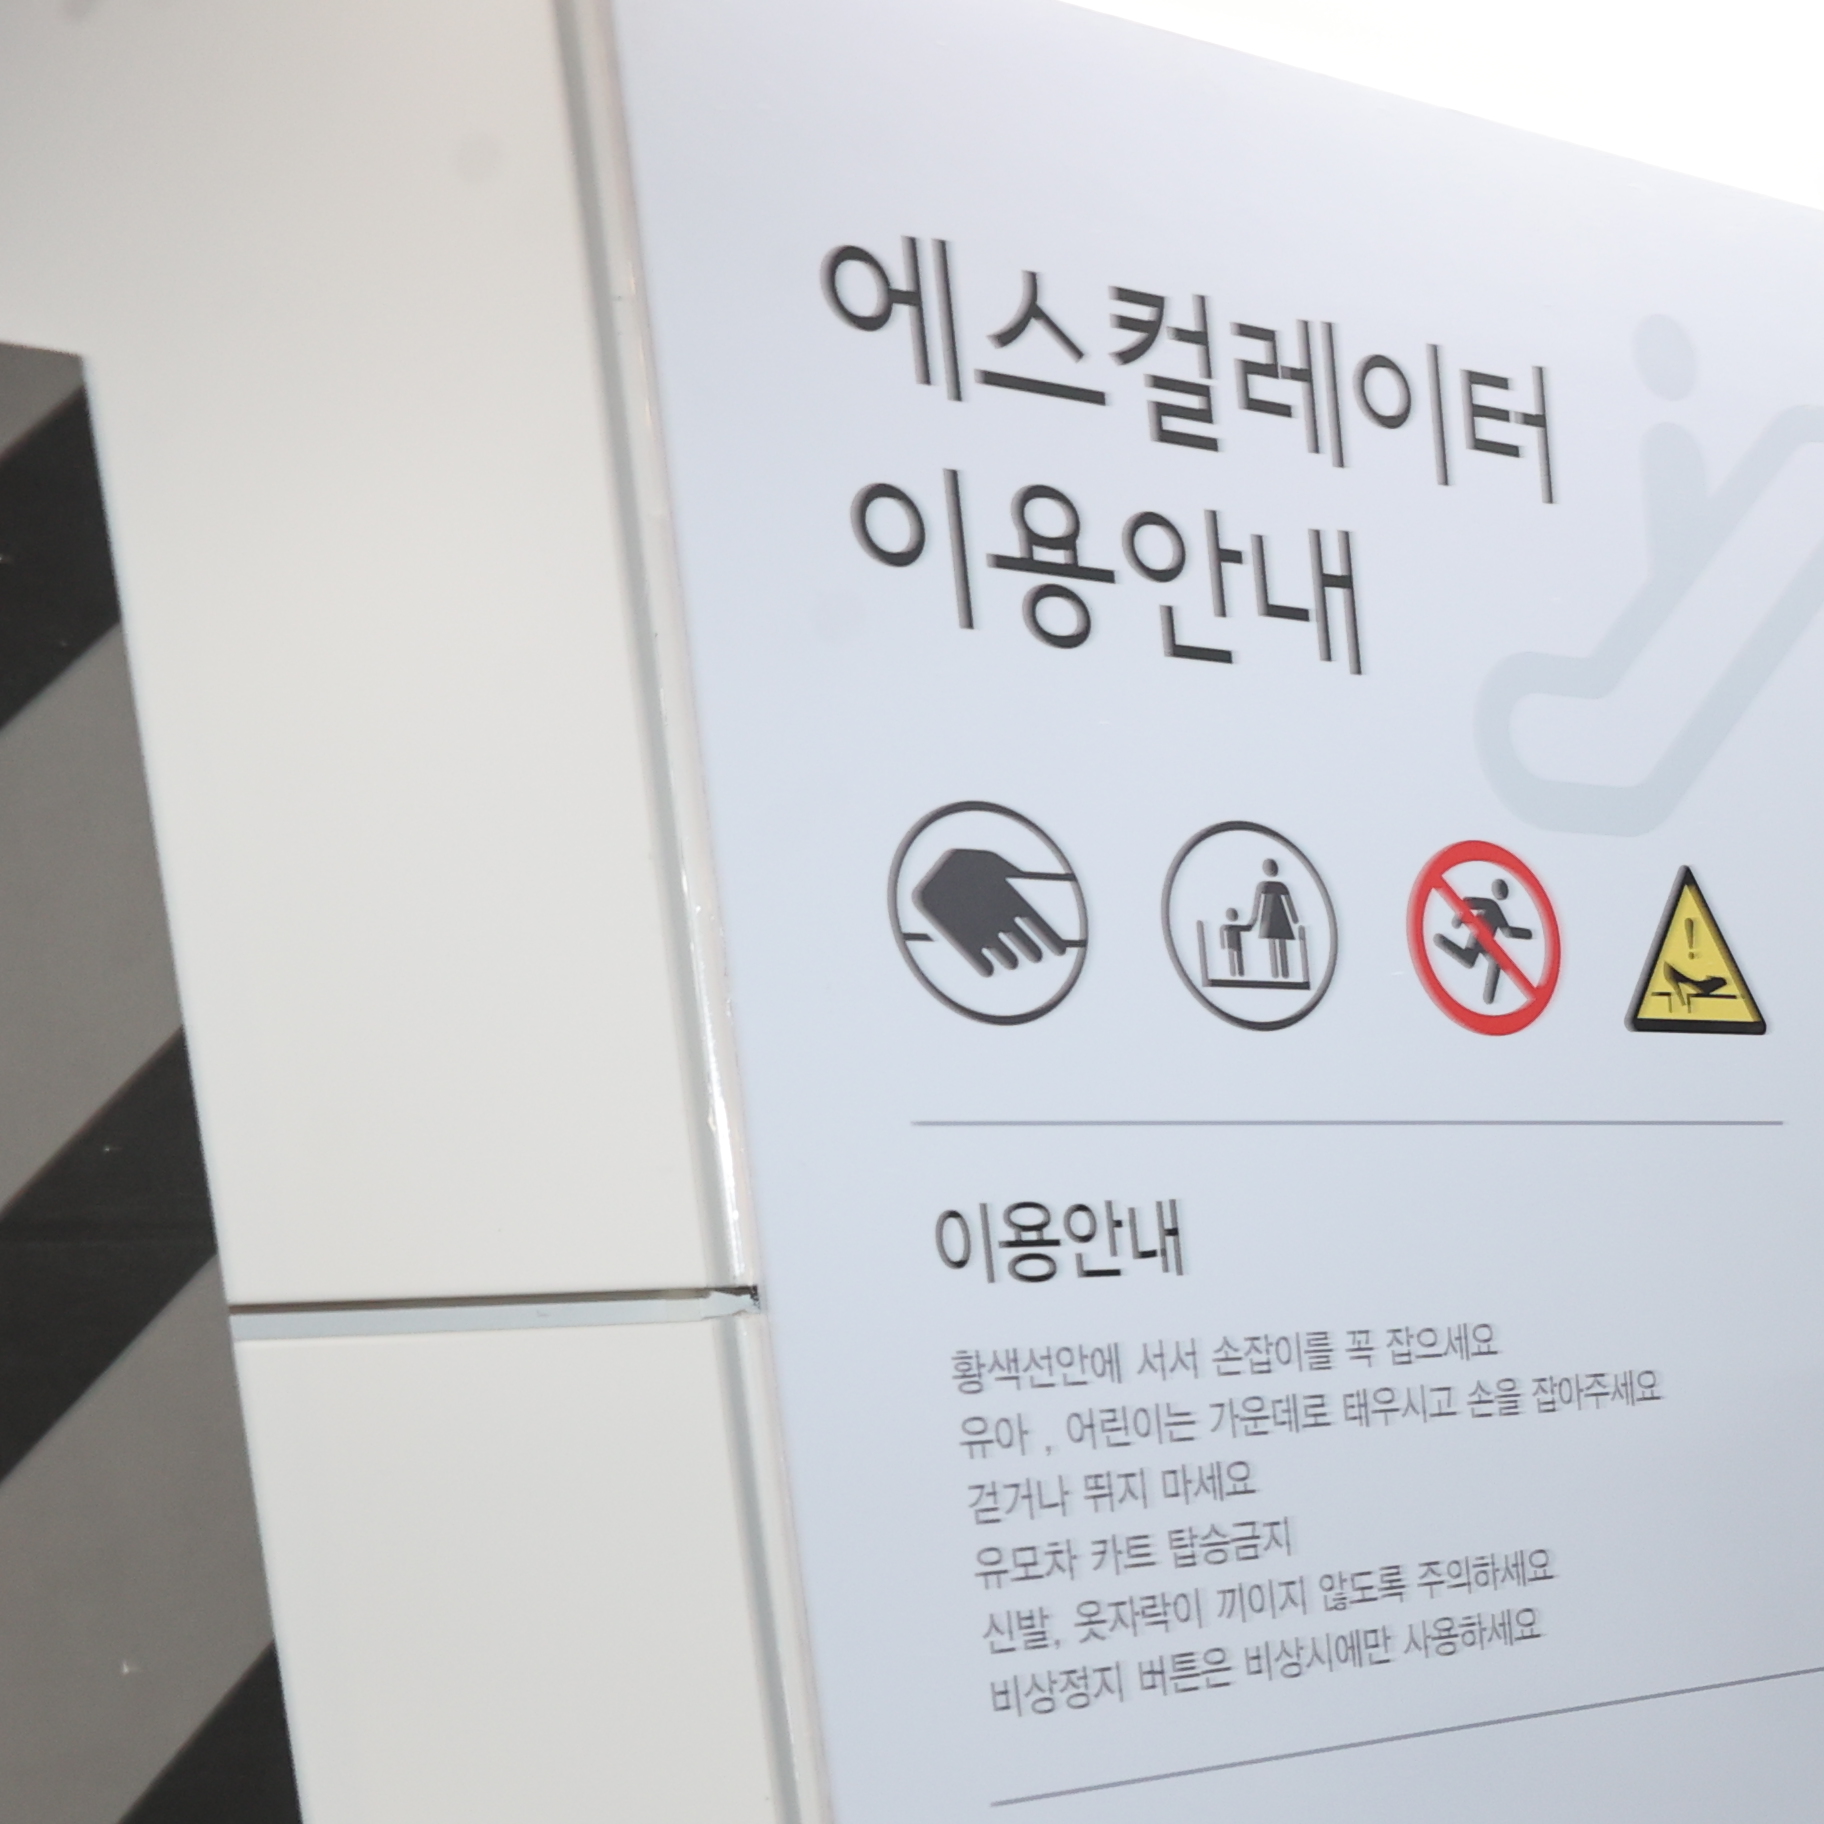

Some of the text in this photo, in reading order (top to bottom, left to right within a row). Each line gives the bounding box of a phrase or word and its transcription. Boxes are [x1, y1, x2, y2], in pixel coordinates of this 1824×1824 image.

[819, 235, 1558, 505] 에스컬레이터
[849, 467, 1365, 676] 이용안내
[934, 1198, 1185, 1284] 이용안내
[951, 1322, 1499, 1395] 황색선안에 서서 손잡이를 꼭 잡으세요
[959, 1412, 1029, 1459] 유아
[1066, 1402, 1197, 1450] 어린이는
[1209, 1392, 1332, 1438] 가운데로
[1343, 1383, 1458, 1428] 태우시고
[1466, 1377, 1522, 1419] 손을
[1531, 1369, 1662, 1414] 잡아주세요
[967, 1460, 1258, 1525] 걷거나 뛰지 마세요
[974, 1515, 1292, 1590] 유모차 카트 탑승금지
[983, 1548, 1555, 1655] 신발, 옷자락이 끼이지 않도록 주의하세요
[990, 1607, 1541, 1718] 비상정지 버튼은 비상시에만 사용하세요
